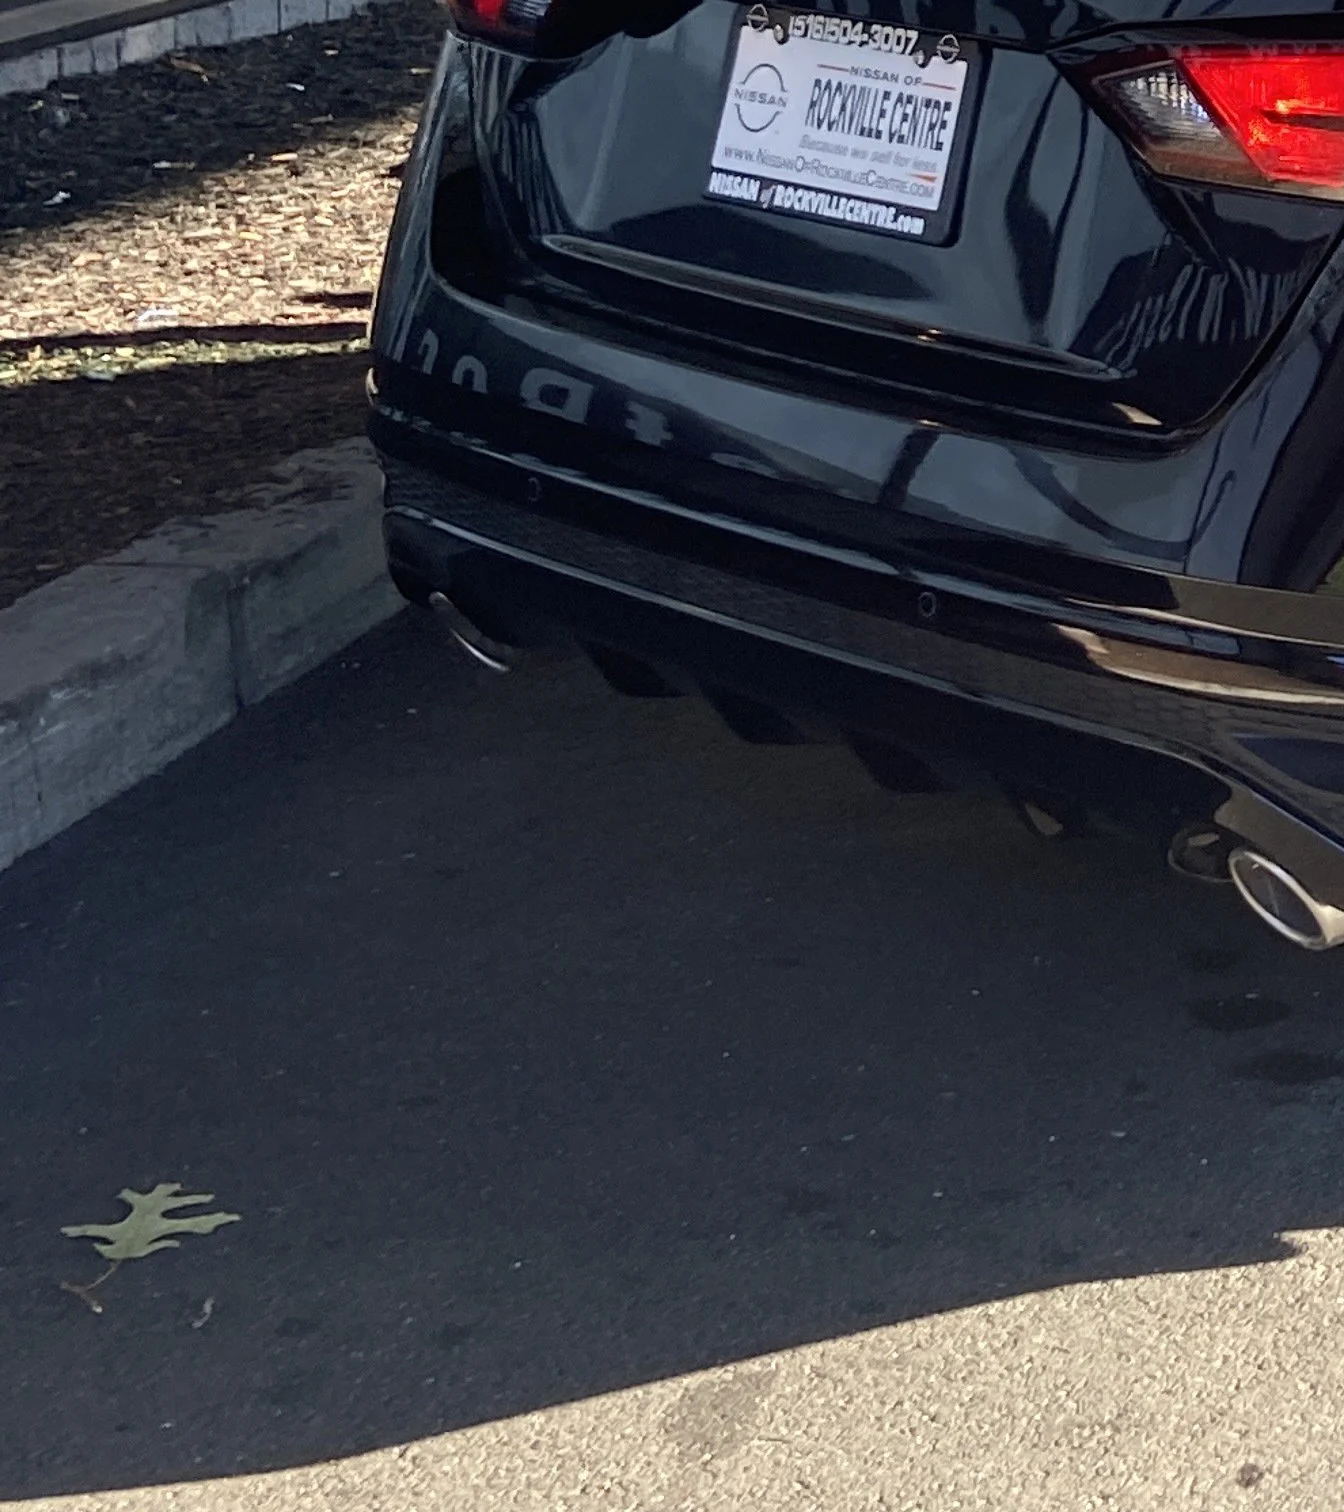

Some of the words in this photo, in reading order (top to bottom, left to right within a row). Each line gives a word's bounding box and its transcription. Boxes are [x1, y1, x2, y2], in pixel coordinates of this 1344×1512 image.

[850, 66, 899, 83] NISSAN
[903, 74, 924, 87] OF
[734, 88, 787, 108] NISSAN
[804, 78, 892, 140] ROCKVILLE
[888, 91, 952, 152] CENTRE
[709, 171, 761, 202] NISSAN
